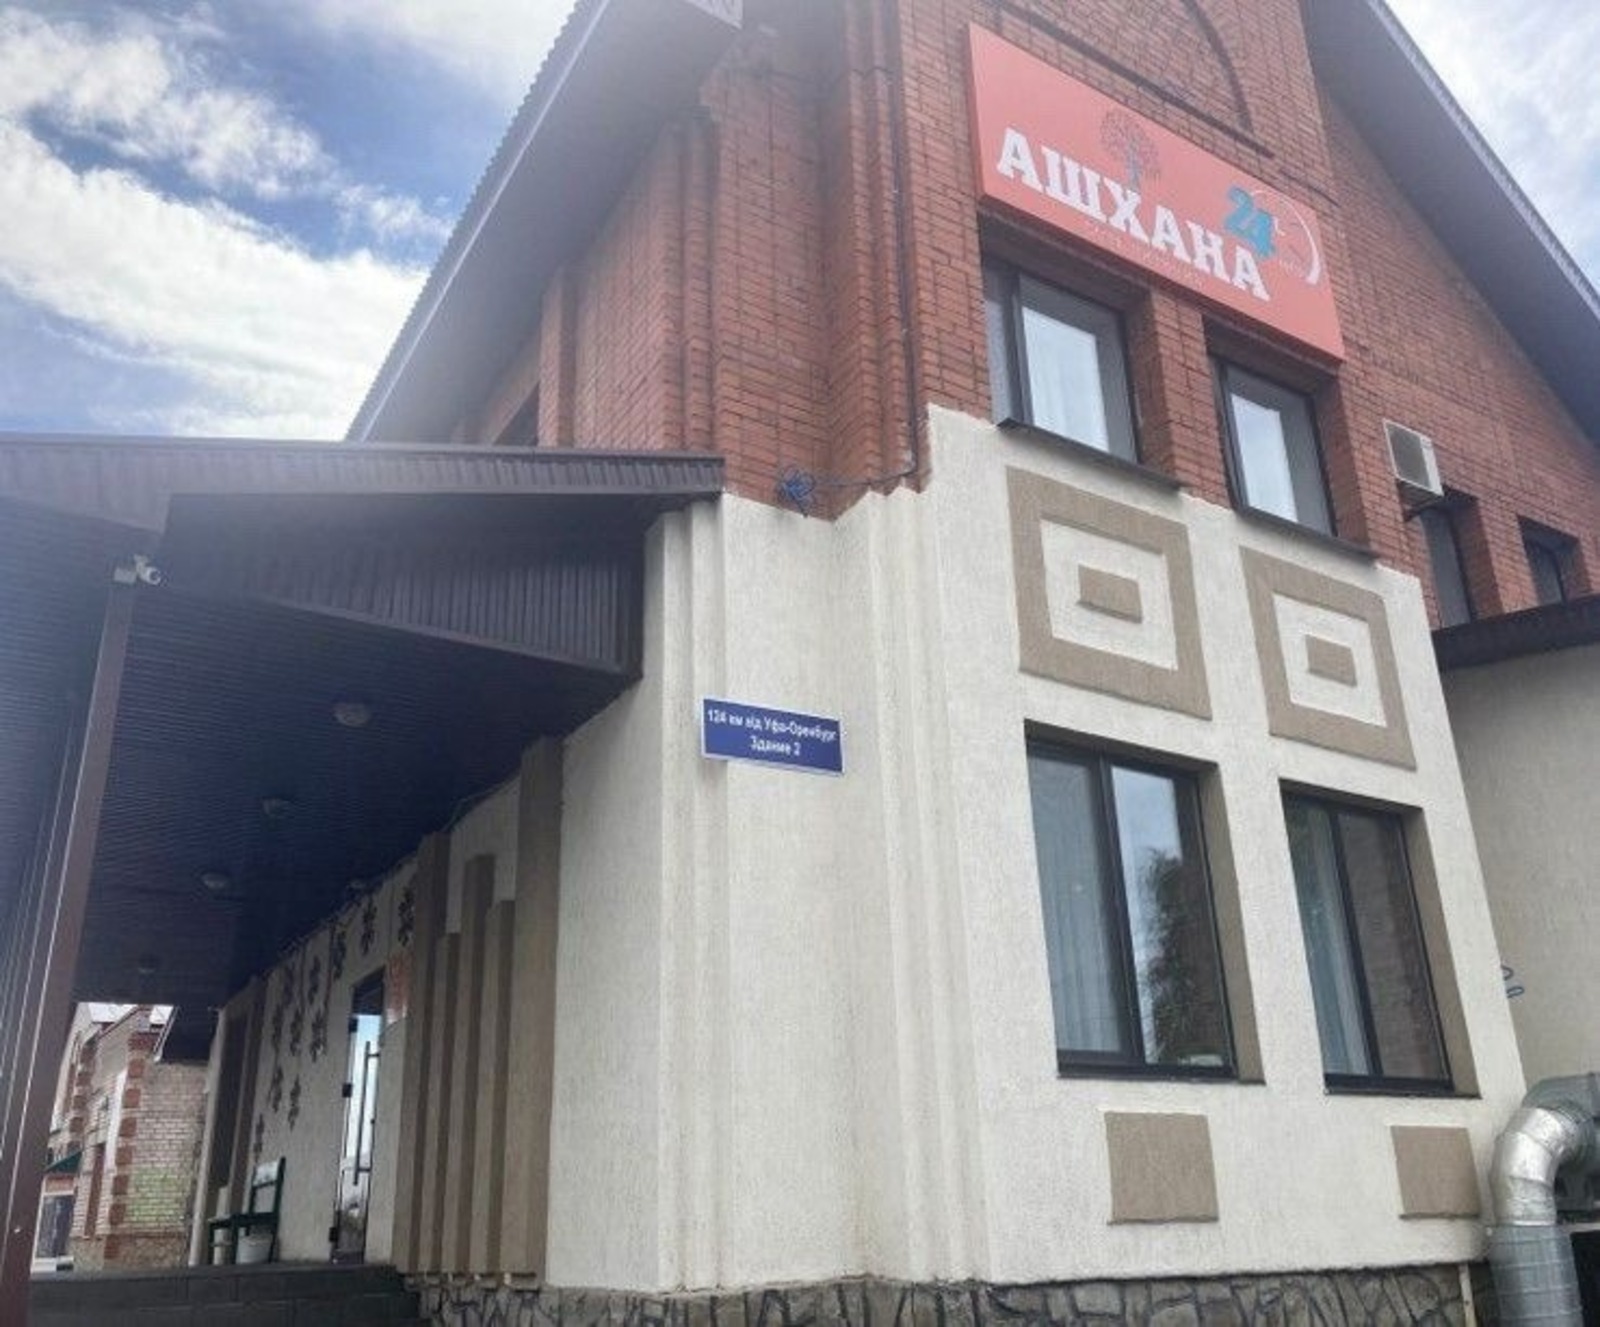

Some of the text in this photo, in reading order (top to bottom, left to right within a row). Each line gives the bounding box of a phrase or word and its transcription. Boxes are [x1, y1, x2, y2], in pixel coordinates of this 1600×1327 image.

[996, 127, 1270, 301] АШХАНА
[750, 736, 801, 756] Здание 2
